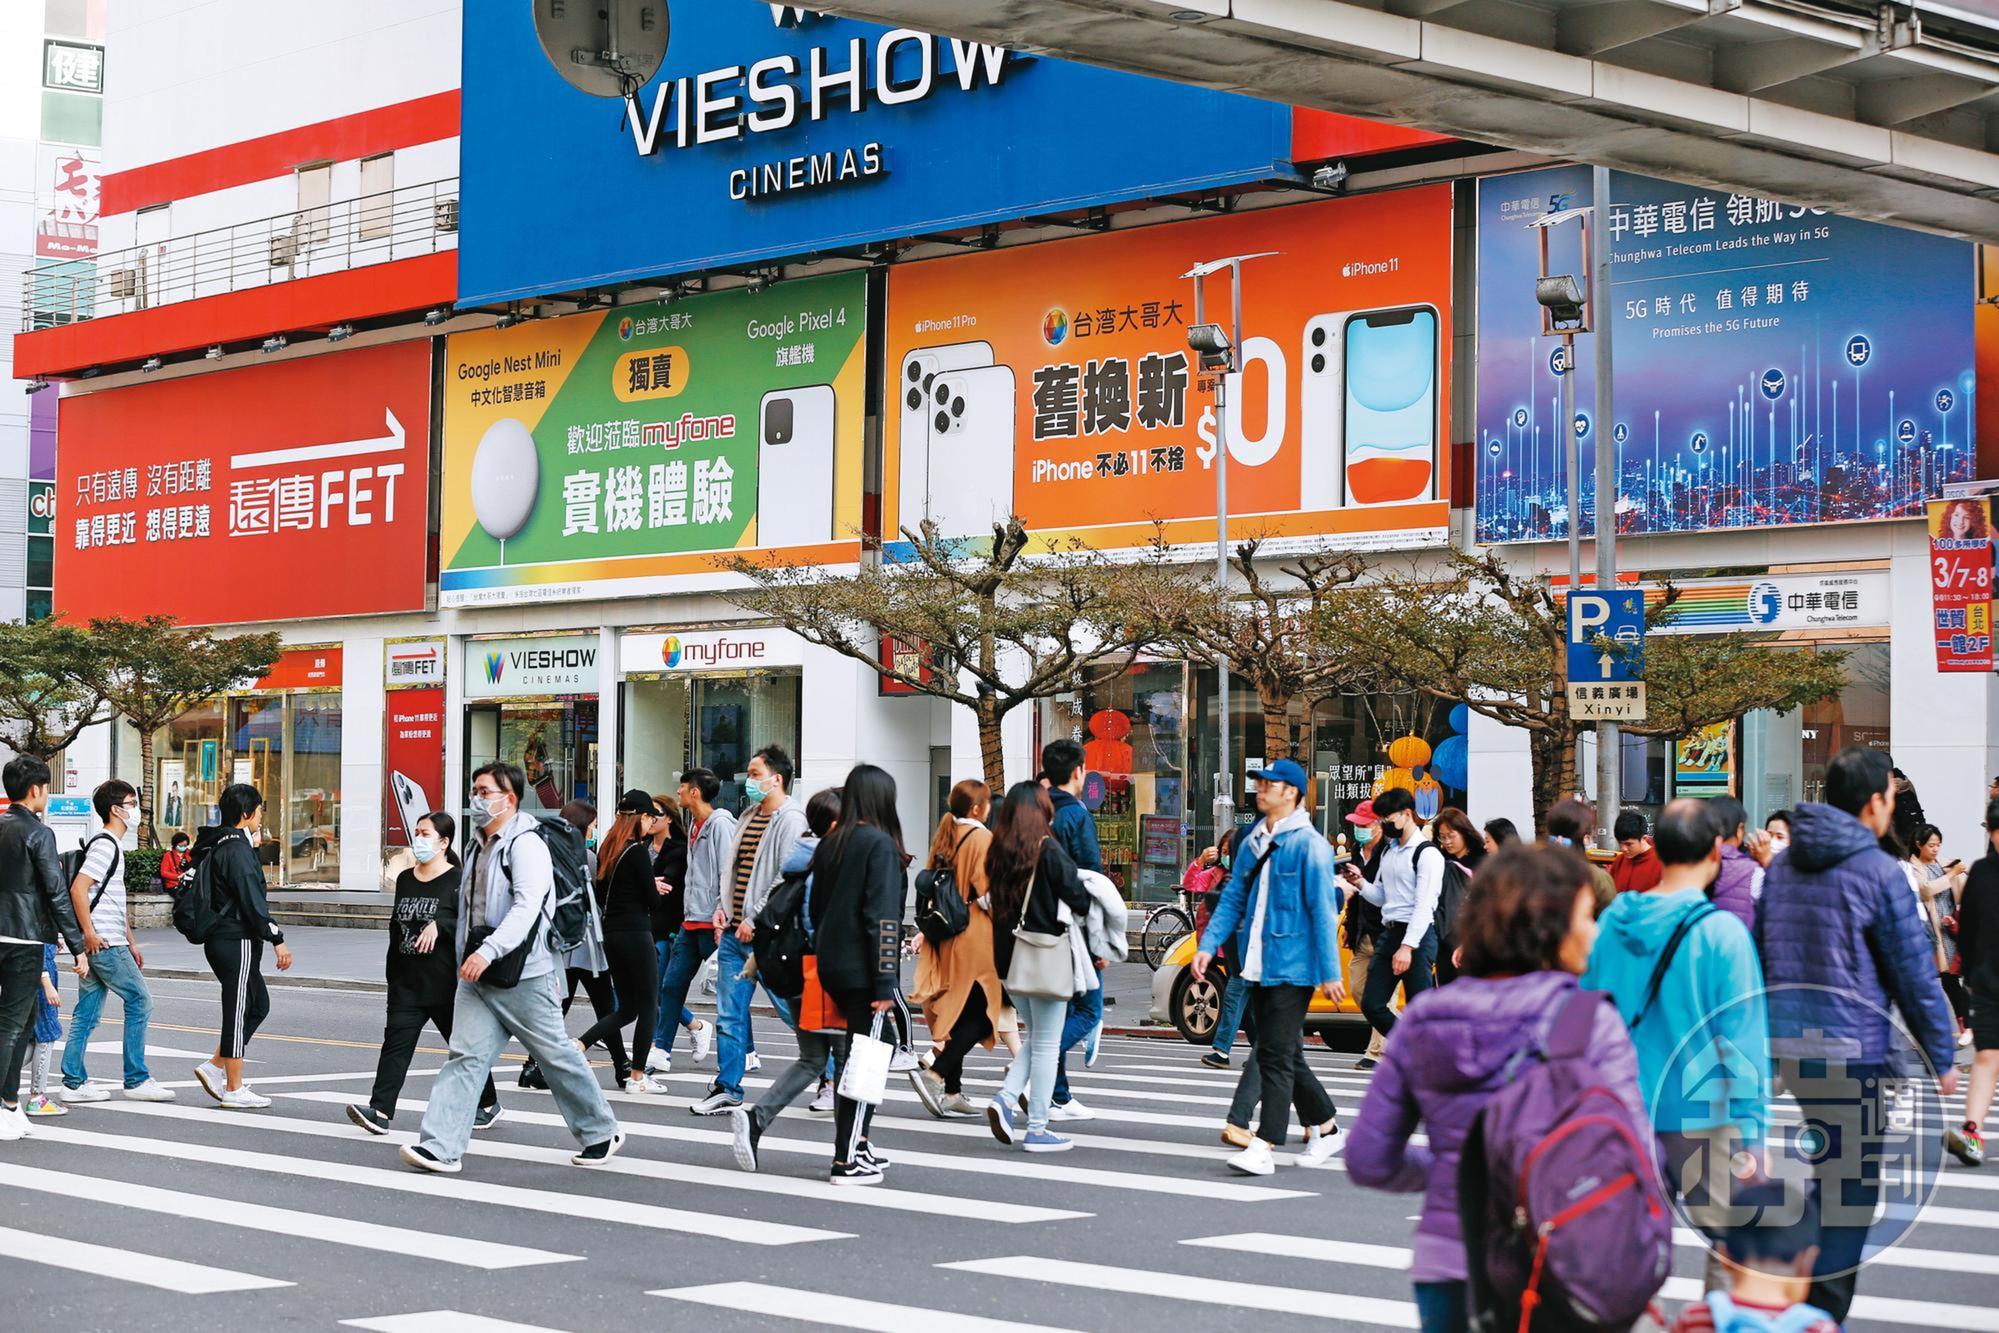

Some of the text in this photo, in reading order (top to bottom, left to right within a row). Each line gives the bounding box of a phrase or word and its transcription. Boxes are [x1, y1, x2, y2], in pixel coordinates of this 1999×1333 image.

[51, 48, 100, 87] 健
[626, 29, 1005, 156] VIESHOW
[729, 142, 882, 200] CINEMAS
[1501, 197, 1539, 212] 中華電信
[1609, 196, 1716, 242] 中華電信
[1666, 241, 1712, 257] Telecom
[1716, 236, 1748, 252] Leads
[1751, 232, 1770, 247] the
[1774, 230, 1797, 246] Way
[1800, 228, 1811, 241] in
[1814, 226, 1829, 239] 5G
[1350, 257, 1399, 278] iPhone 11
[1625, 280, 1810, 320] 5G 時代 值得期待
[748, 307, 847, 341] Google Pixel 4
[920, 313, 978, 332] iPhone 11 Pro
[1652, 315, 1780, 339] Promises the 5G Future
[458, 349, 561, 381] Google Nest Mini
[775, 343, 816, 368] 旗艦機
[628, 353, 673, 394] 獨賣
[471, 380, 546, 408] 中文化智慧音箱
[1032, 350, 1190, 443] 舊換新
[641, 412, 736, 451] myfone
[76, 458, 212, 507] 只有遠傳 沒有距離
[1032, 458, 1094, 483] iPhone
[321, 463, 405, 528] FET
[561, 455, 735, 538] 實機體驗
[75, 504, 211, 551] 靠得更近 想得更遠
[1934, 557, 1989, 588] 3/7-8
[1788, 590, 1858, 612] 中華電信
[1571, 596, 1611, 644] P
[1806, 613, 1858, 624] Chunghwa Telecom
[1972, 605, 1985, 630] 台北
[414, 659, 436, 675] FET
[511, 648, 596, 669] VIESHOW
[684, 637, 765, 666] myfone
[522, 674, 580, 685] CINEMAS
[1575, 686, 1639, 700] 信義廣場
[1584, 703, 1632, 716] Xinyi
